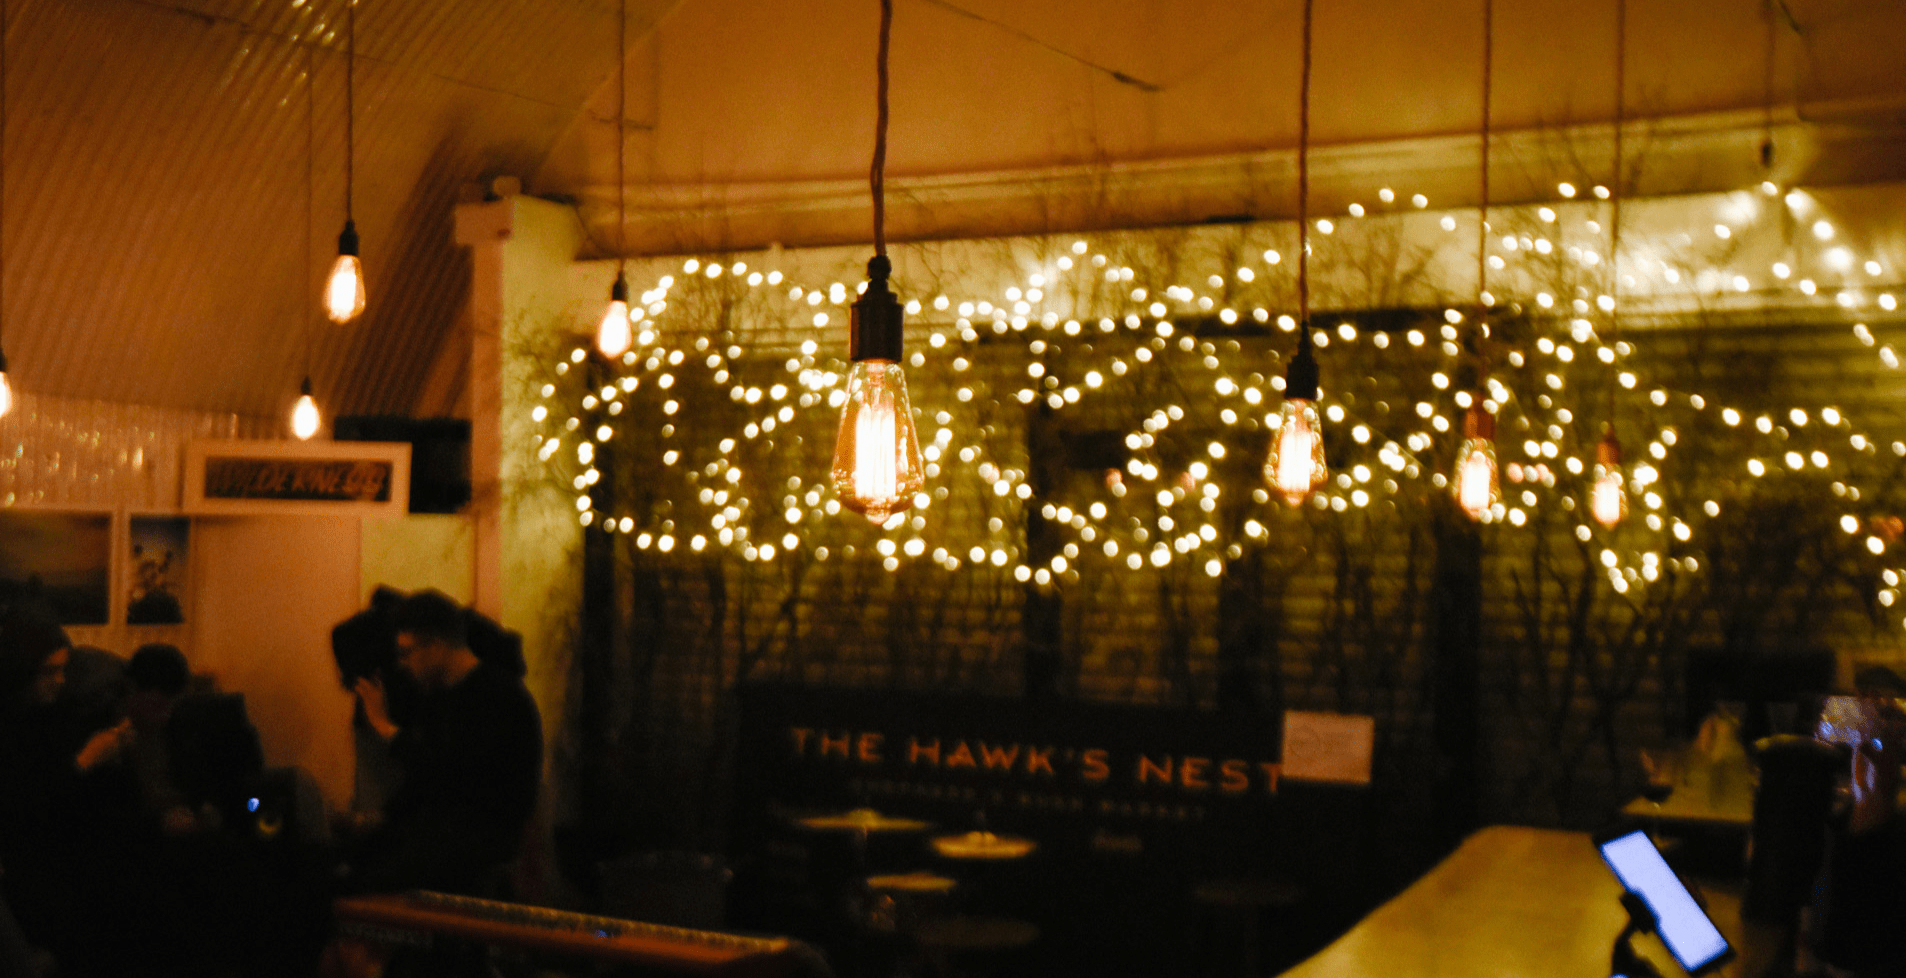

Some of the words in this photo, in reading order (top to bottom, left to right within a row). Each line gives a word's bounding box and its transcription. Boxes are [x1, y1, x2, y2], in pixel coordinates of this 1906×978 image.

[791, 727, 882, 763] THE
[908, 737, 1110, 782] HAWK'S
[1137, 754, 1283, 794] NEST
